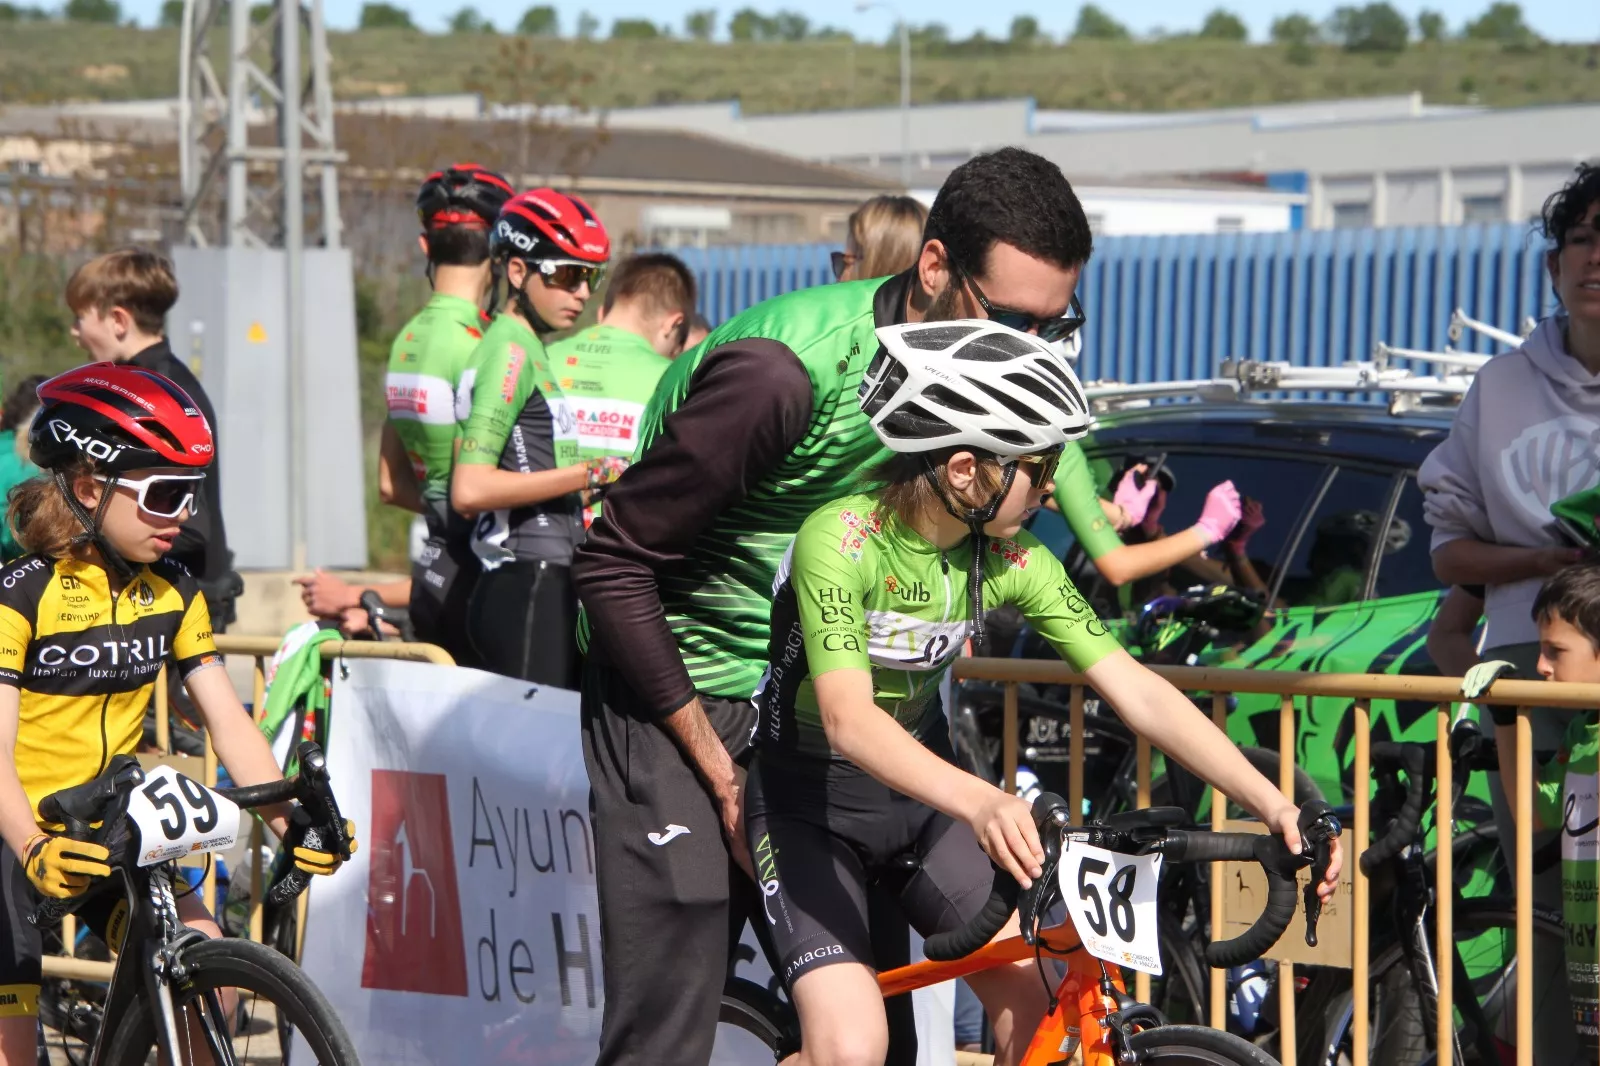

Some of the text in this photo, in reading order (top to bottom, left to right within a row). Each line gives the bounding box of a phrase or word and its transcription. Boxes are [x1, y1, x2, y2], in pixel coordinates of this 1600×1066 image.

[38, 634, 169, 667] COTRIL
[142, 772, 218, 841] 59
[1078, 856, 1137, 944] 58
[477, 908, 536, 1003] de
